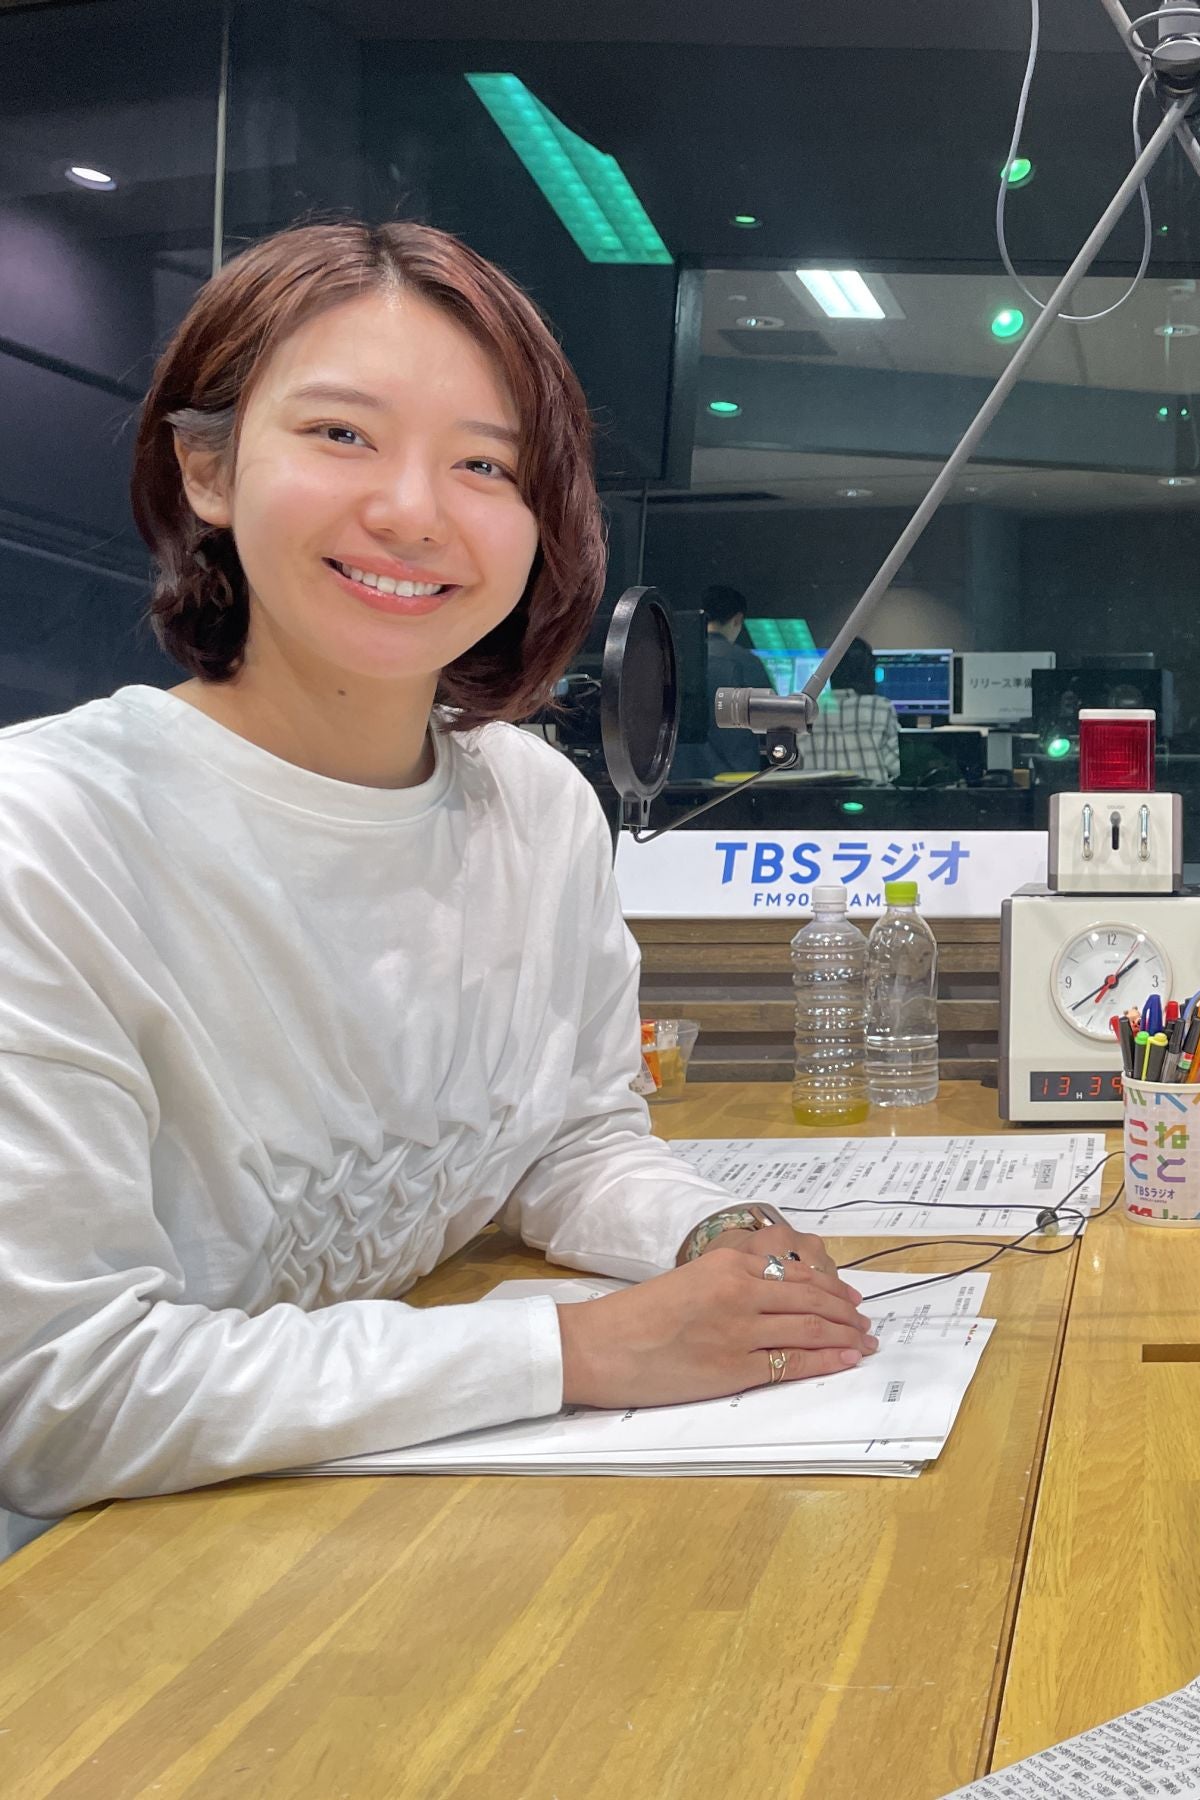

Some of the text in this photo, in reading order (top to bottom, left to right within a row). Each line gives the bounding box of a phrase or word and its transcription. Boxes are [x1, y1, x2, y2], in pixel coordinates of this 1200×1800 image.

[715, 841, 970, 885] TBSラジオ
[1106, 933, 1117, 946] 12
[1065, 976, 1072, 989] 9
[1152, 975, 1159, 987] 3
[1134, 1185, 1175, 1199] TBSラジオ
